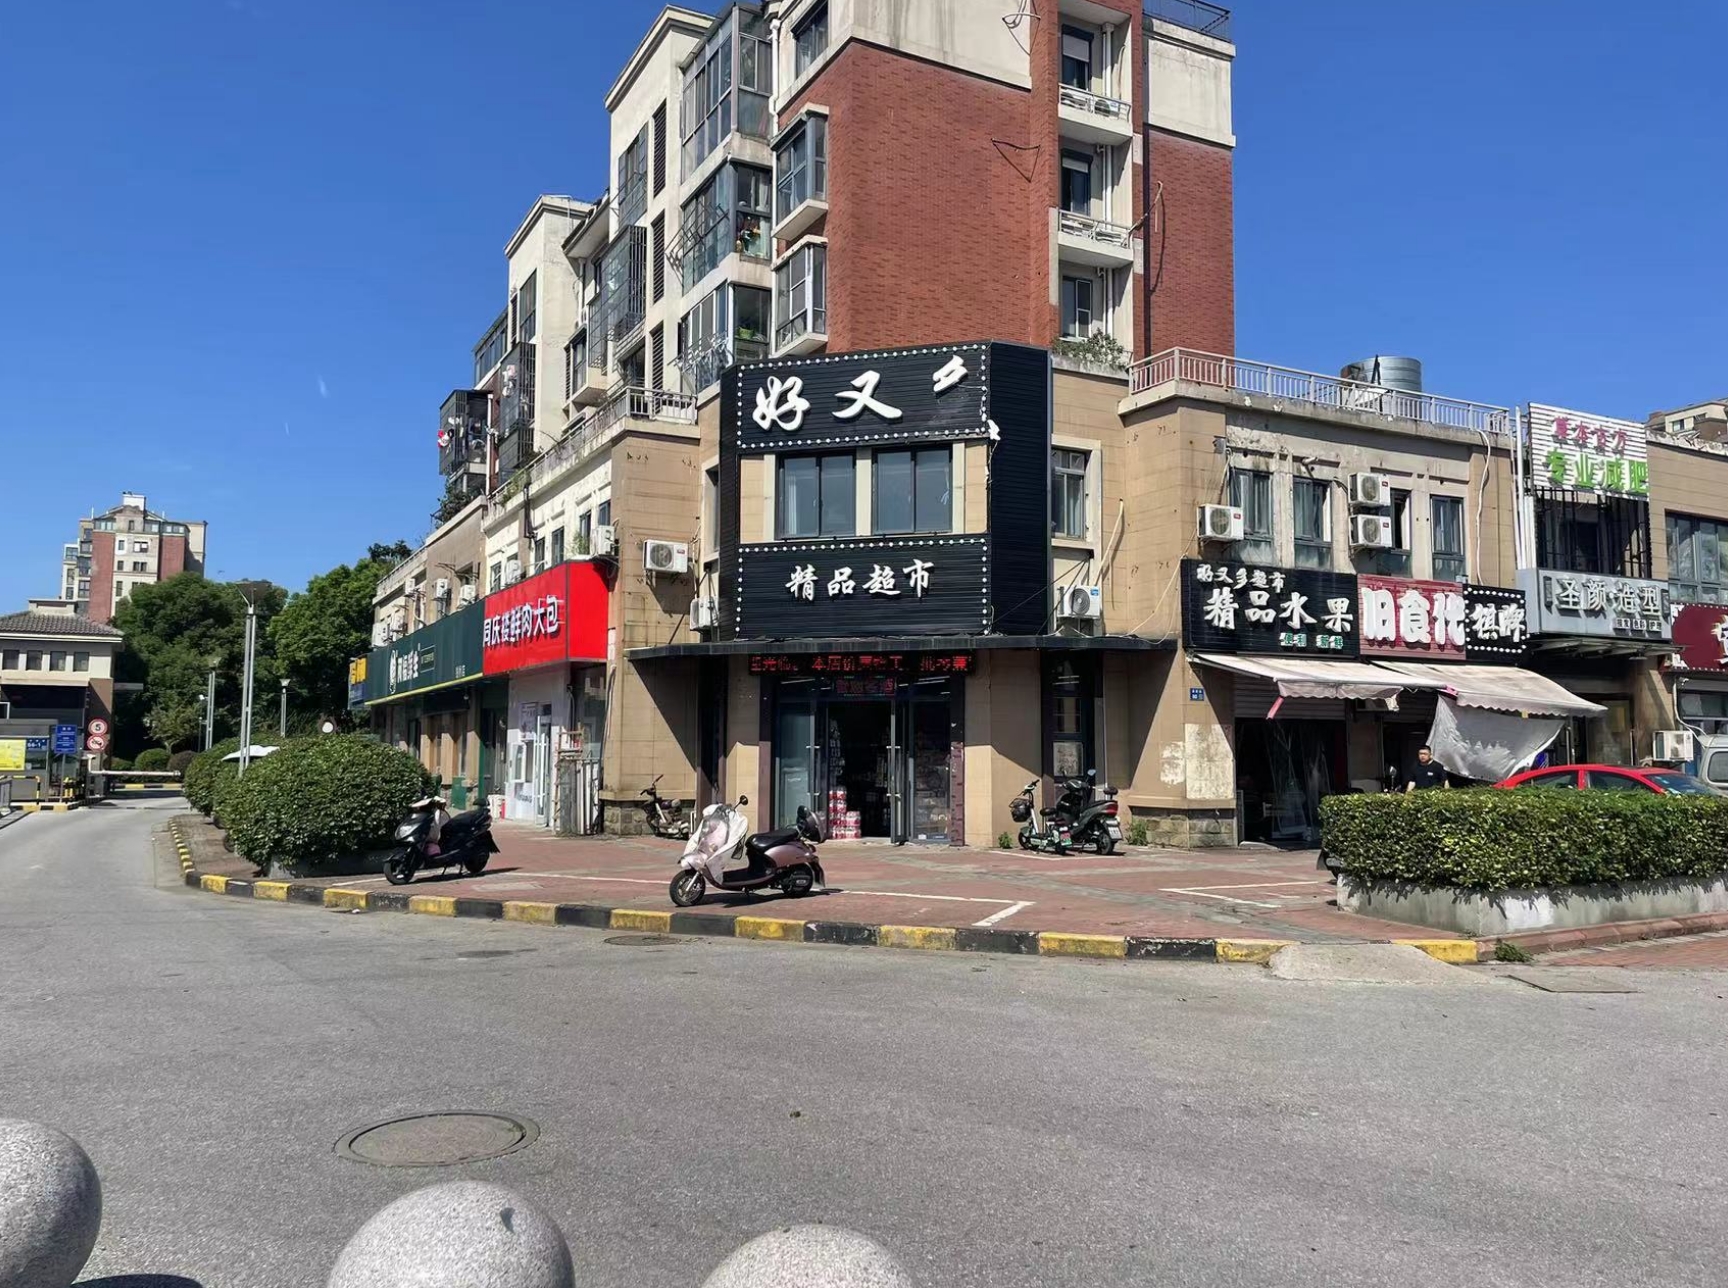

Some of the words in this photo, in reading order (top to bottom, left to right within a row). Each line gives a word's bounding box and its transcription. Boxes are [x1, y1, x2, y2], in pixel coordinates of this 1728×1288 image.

[1546, 447, 1648, 495] 专业减肥
[785, 559, 935, 601] 精品超市
[1196, 563, 1286, 593] 好又多超市
[1203, 587, 1355, 632] 精品水果
[1361, 587, 1466, 646] 旧食代
[1471, 602, 1526, 643] 棋牌
[94, 723, 102, 732] 5
